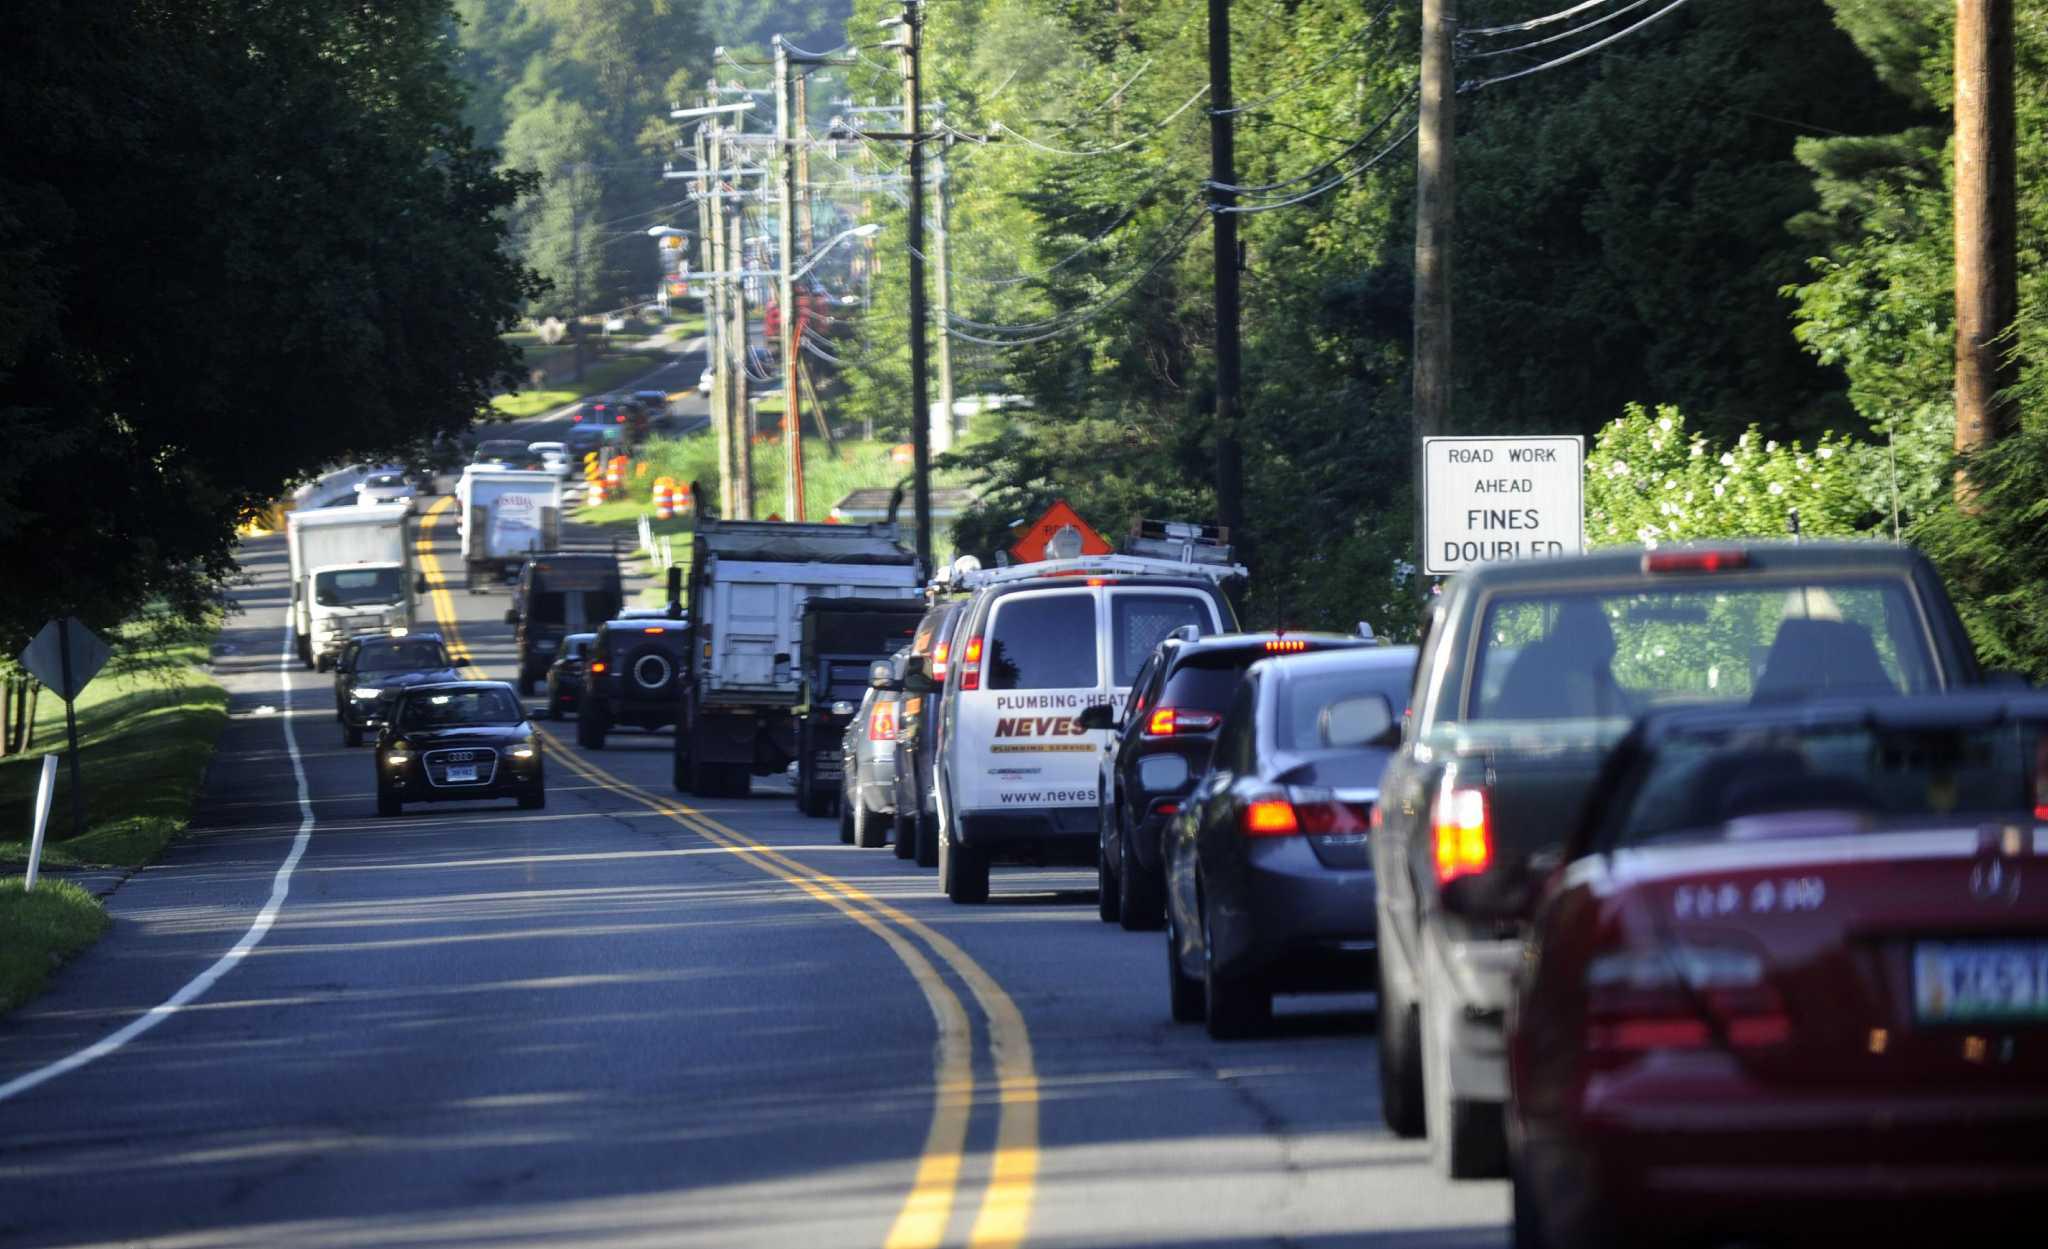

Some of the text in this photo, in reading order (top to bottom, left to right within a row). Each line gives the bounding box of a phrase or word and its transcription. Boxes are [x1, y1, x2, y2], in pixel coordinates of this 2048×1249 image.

[1449, 448, 1557, 463] ROAD WORK
[1474, 479, 1533, 493] AHEAD
[1467, 509, 1540, 530] FINES
[994, 716, 1089, 738] NEVES
